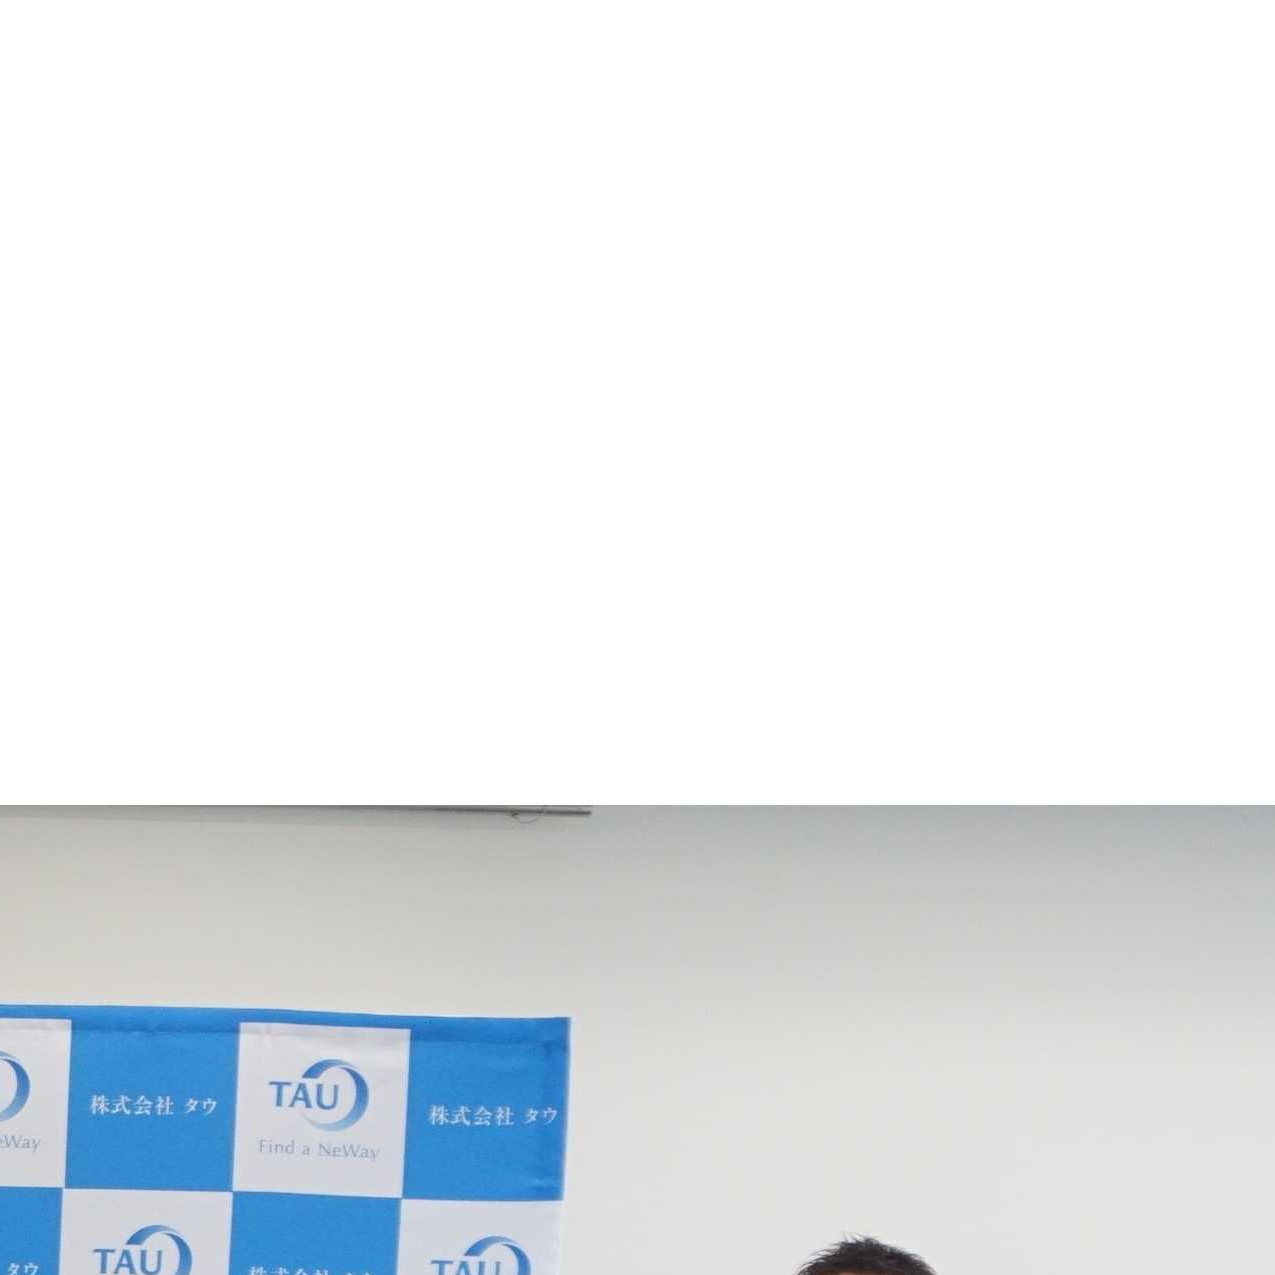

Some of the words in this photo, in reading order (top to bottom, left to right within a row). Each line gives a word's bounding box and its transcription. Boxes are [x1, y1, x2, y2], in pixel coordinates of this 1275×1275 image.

[89, 1094, 174, 1116] 株式会社
[184, 1097, 218, 1115] タウ
[268, 1080, 339, 1111] TAU
[428, 1104, 514, 1127] 株式会社
[525, 1107, 558, 1124] タウ
[258, 1139, 295, 1155] Find
[301, 1144, 311, 1156] a
[317, 1143, 380, 1162] NeWay
